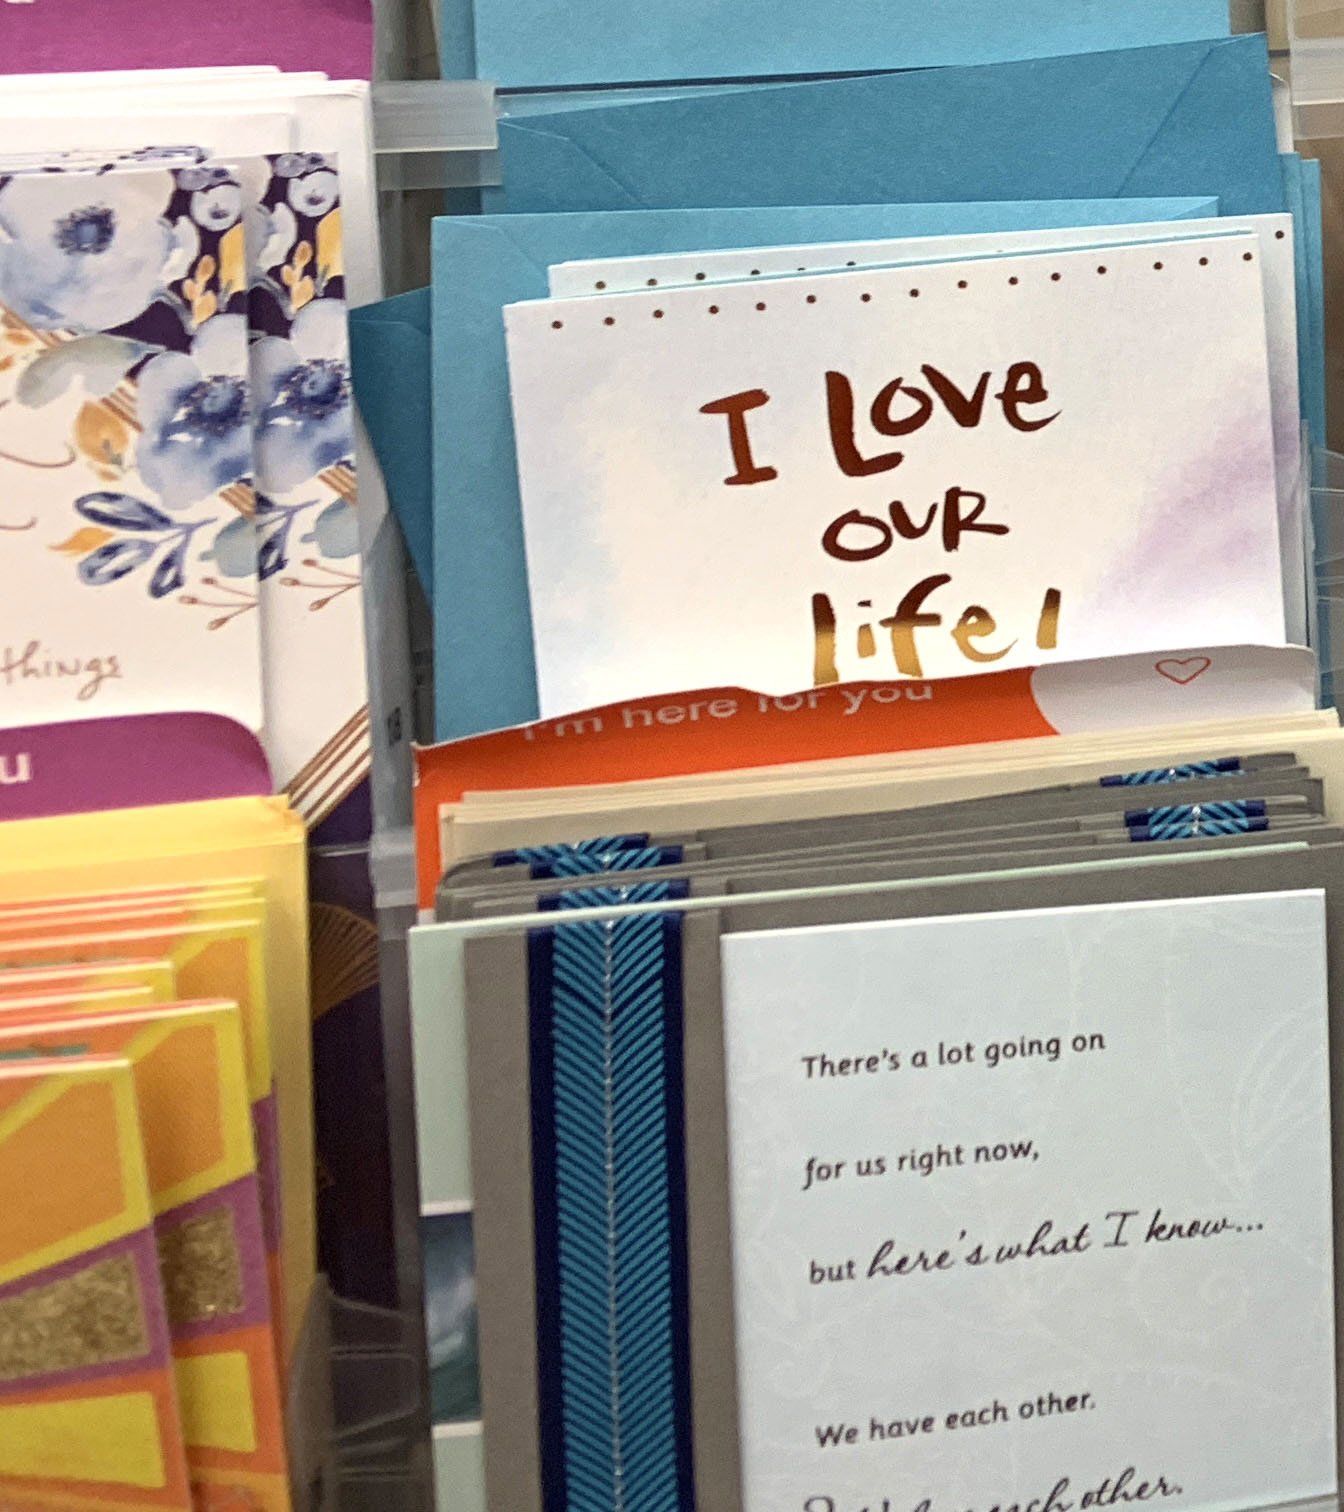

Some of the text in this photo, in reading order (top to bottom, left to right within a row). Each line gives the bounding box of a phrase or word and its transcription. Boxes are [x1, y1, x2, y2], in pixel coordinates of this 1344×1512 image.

[699, 362, 1060, 485] I Love
[802, 1034, 1105, 1078] There's a lot going on
[802, 1137, 1040, 1191] for us right now,
